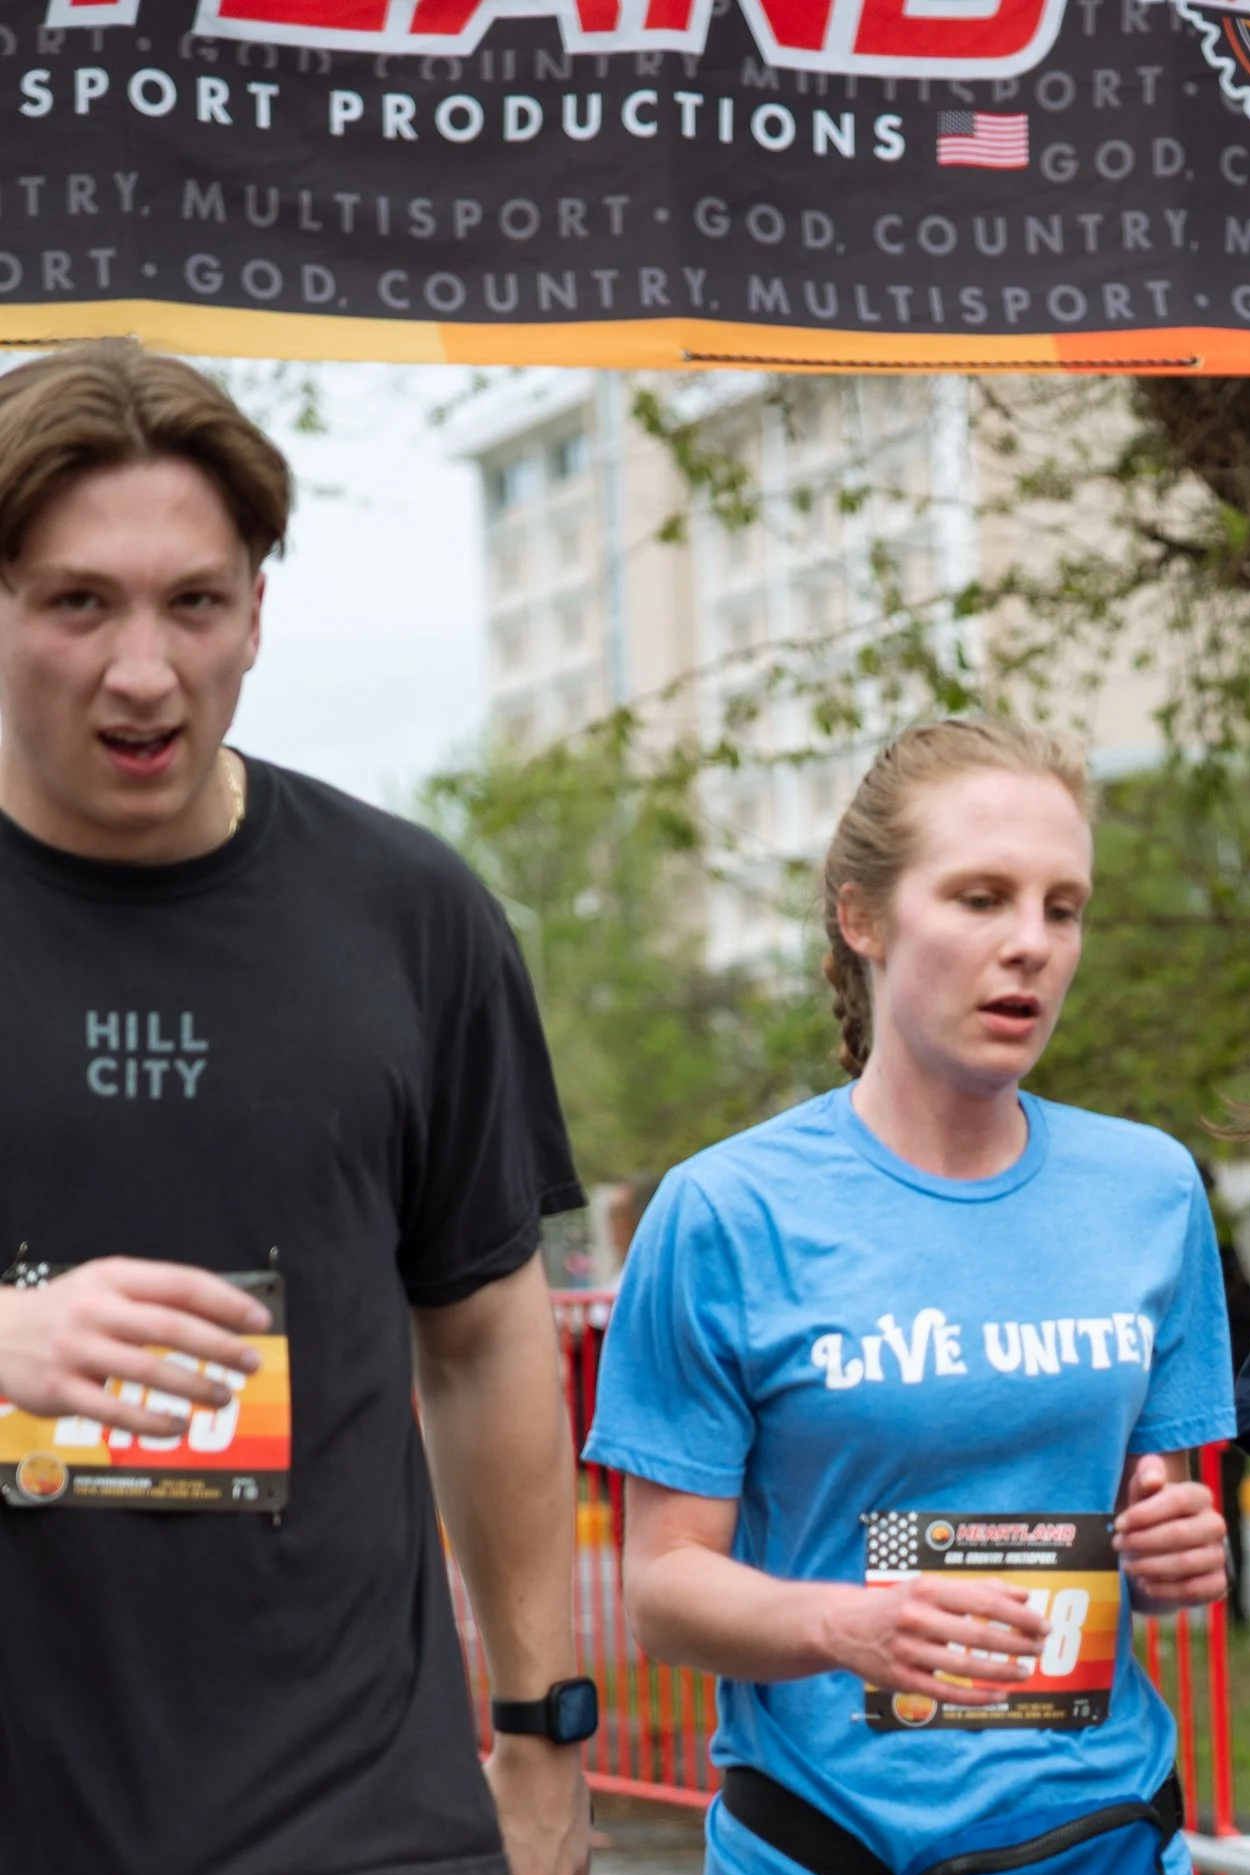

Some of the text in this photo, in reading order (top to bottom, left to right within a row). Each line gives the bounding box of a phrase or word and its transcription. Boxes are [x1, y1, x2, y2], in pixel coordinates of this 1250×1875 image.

[18, 66, 906, 162] SPORT PRODUCTIONS
[181, 179, 631, 239] MULTISPORT
[873, 208, 1199, 256] COUNTRY,
[377, 266, 720, 312] COUNTRY,
[747, 274, 1173, 325] MULTISPORT
[86, 1011, 209, 1052] HILL
[87, 1059, 207, 1099] CITY
[810, 1307, 968, 1390] LIVE
